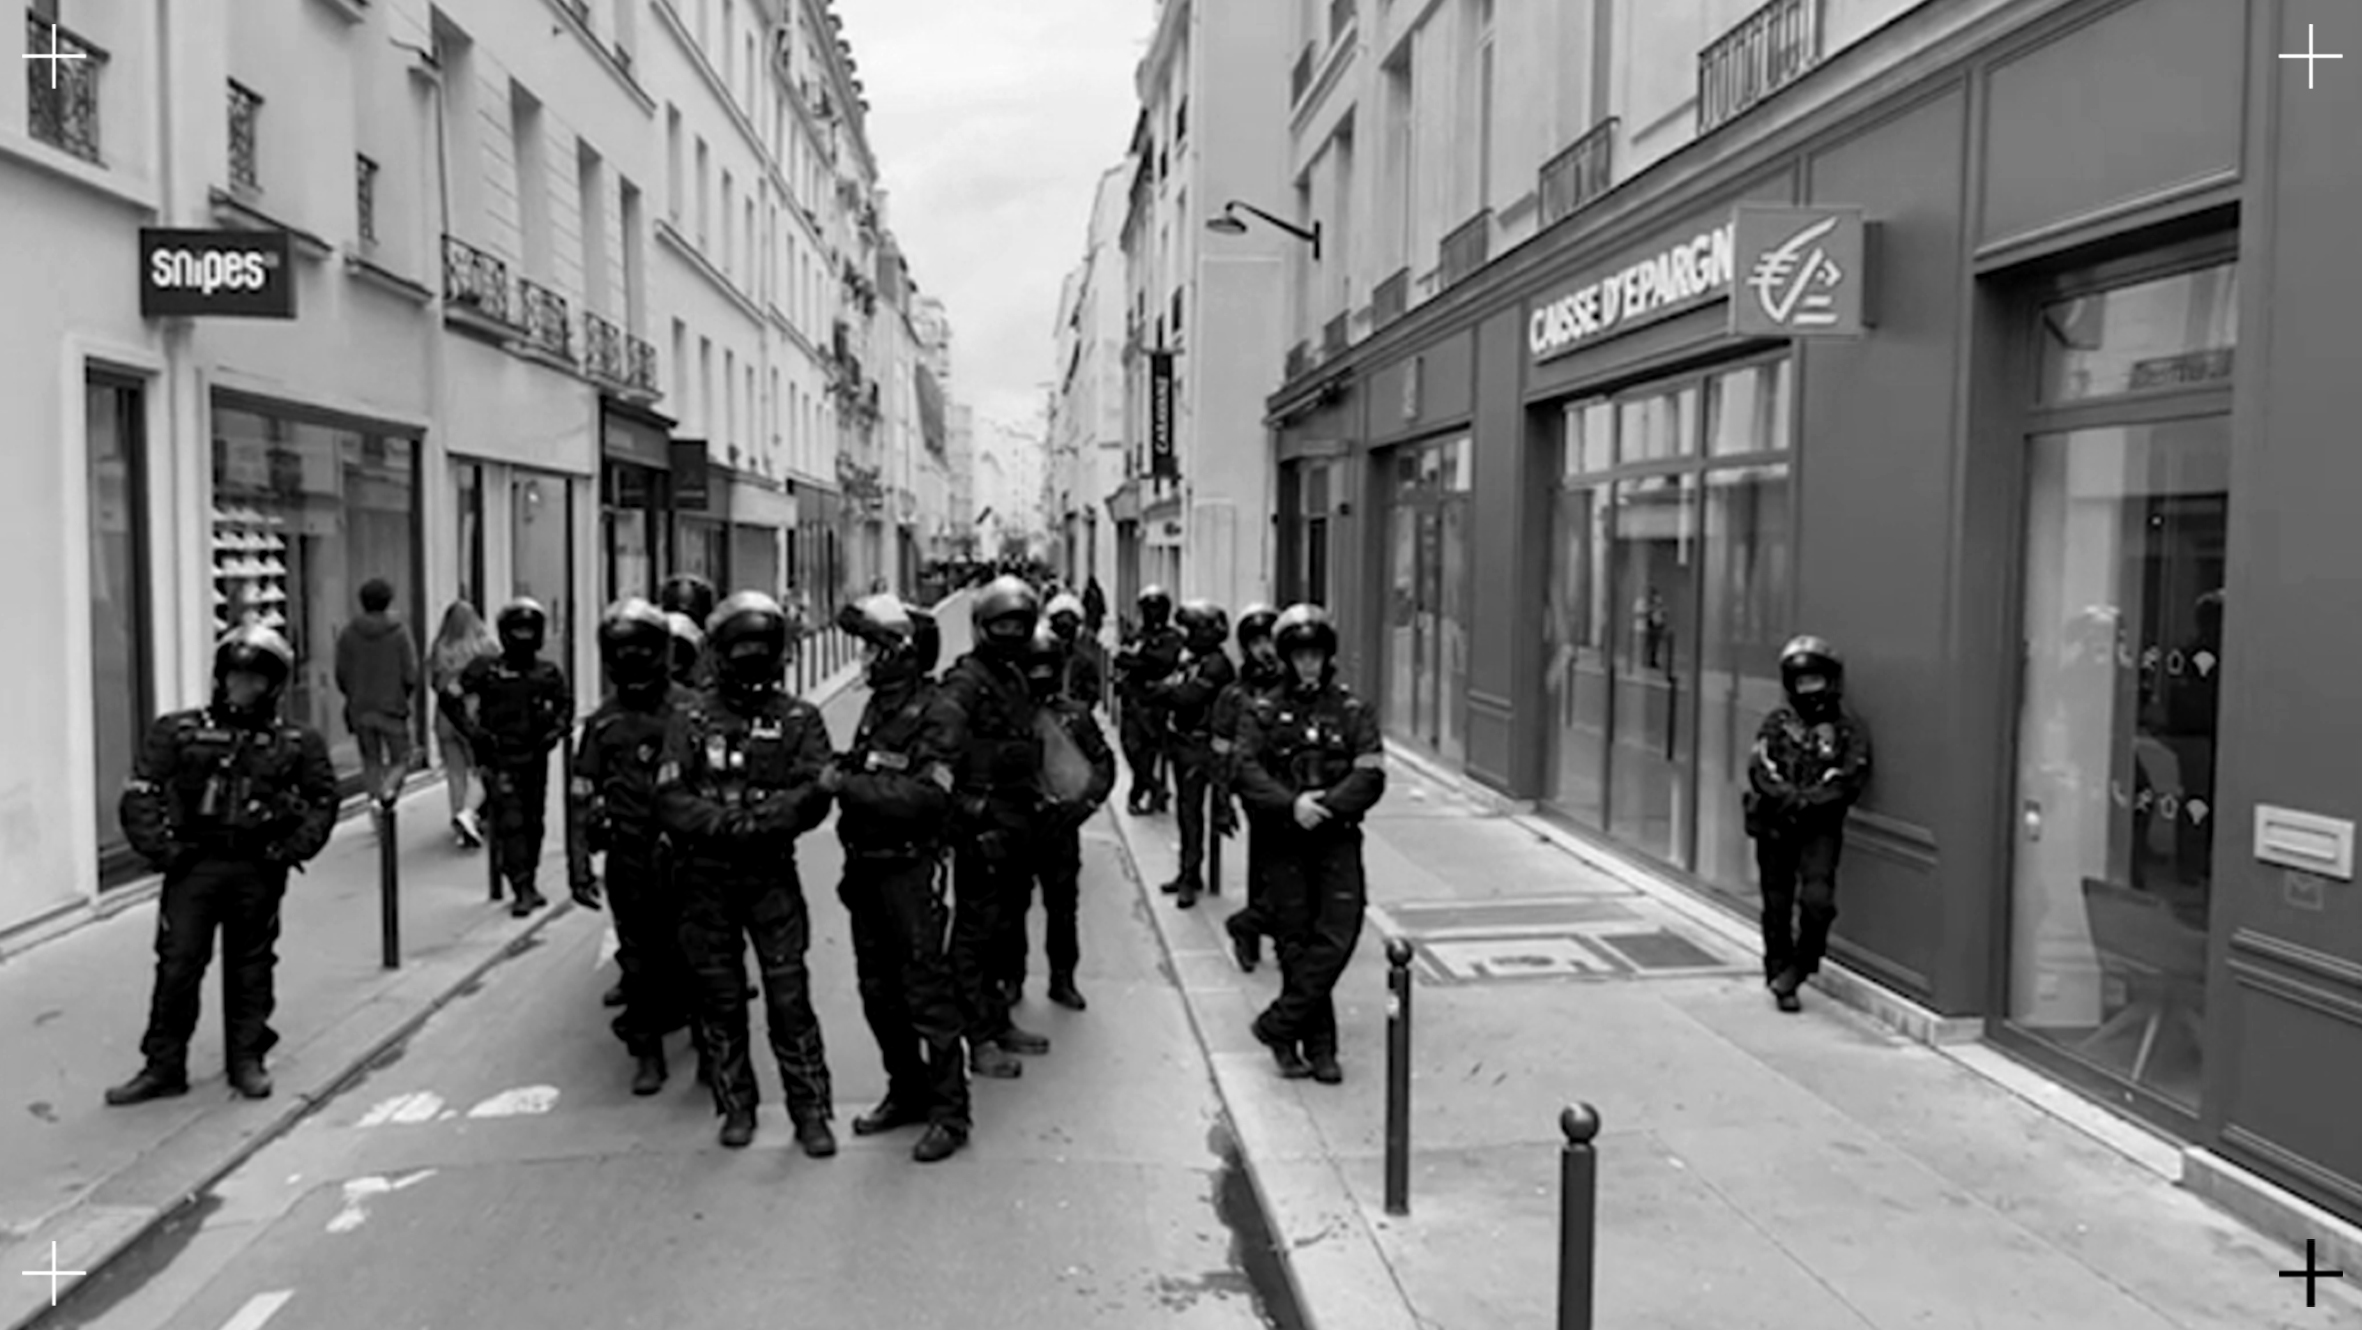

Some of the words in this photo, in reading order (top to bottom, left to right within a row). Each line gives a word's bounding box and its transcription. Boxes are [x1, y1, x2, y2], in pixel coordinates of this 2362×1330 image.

[152, 249, 264, 294] snipes
[1530, 283, 1599, 354] CAISSE
[1602, 222, 1734, 329] D'EPARGN
